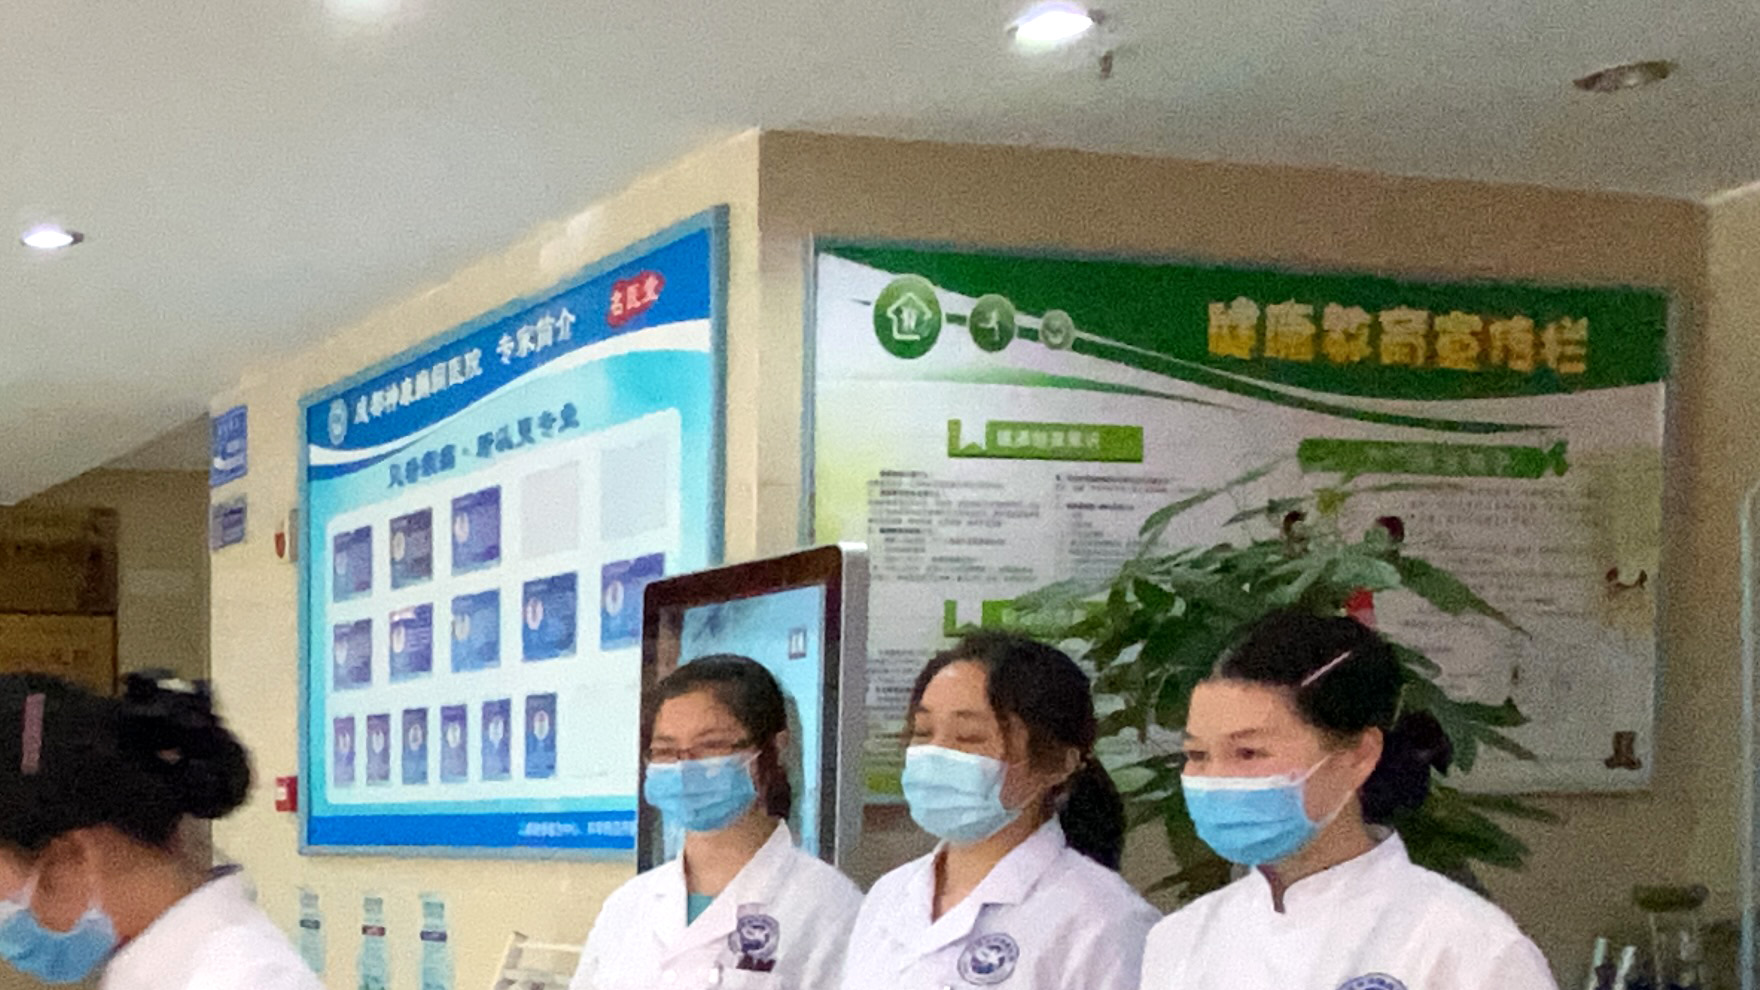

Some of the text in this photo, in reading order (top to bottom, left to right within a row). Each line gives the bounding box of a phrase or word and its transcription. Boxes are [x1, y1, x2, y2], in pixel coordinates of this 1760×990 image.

[496, 307, 577, 365] 专家简介
[1207, 296, 1590, 375] 健康教育宣传栏
